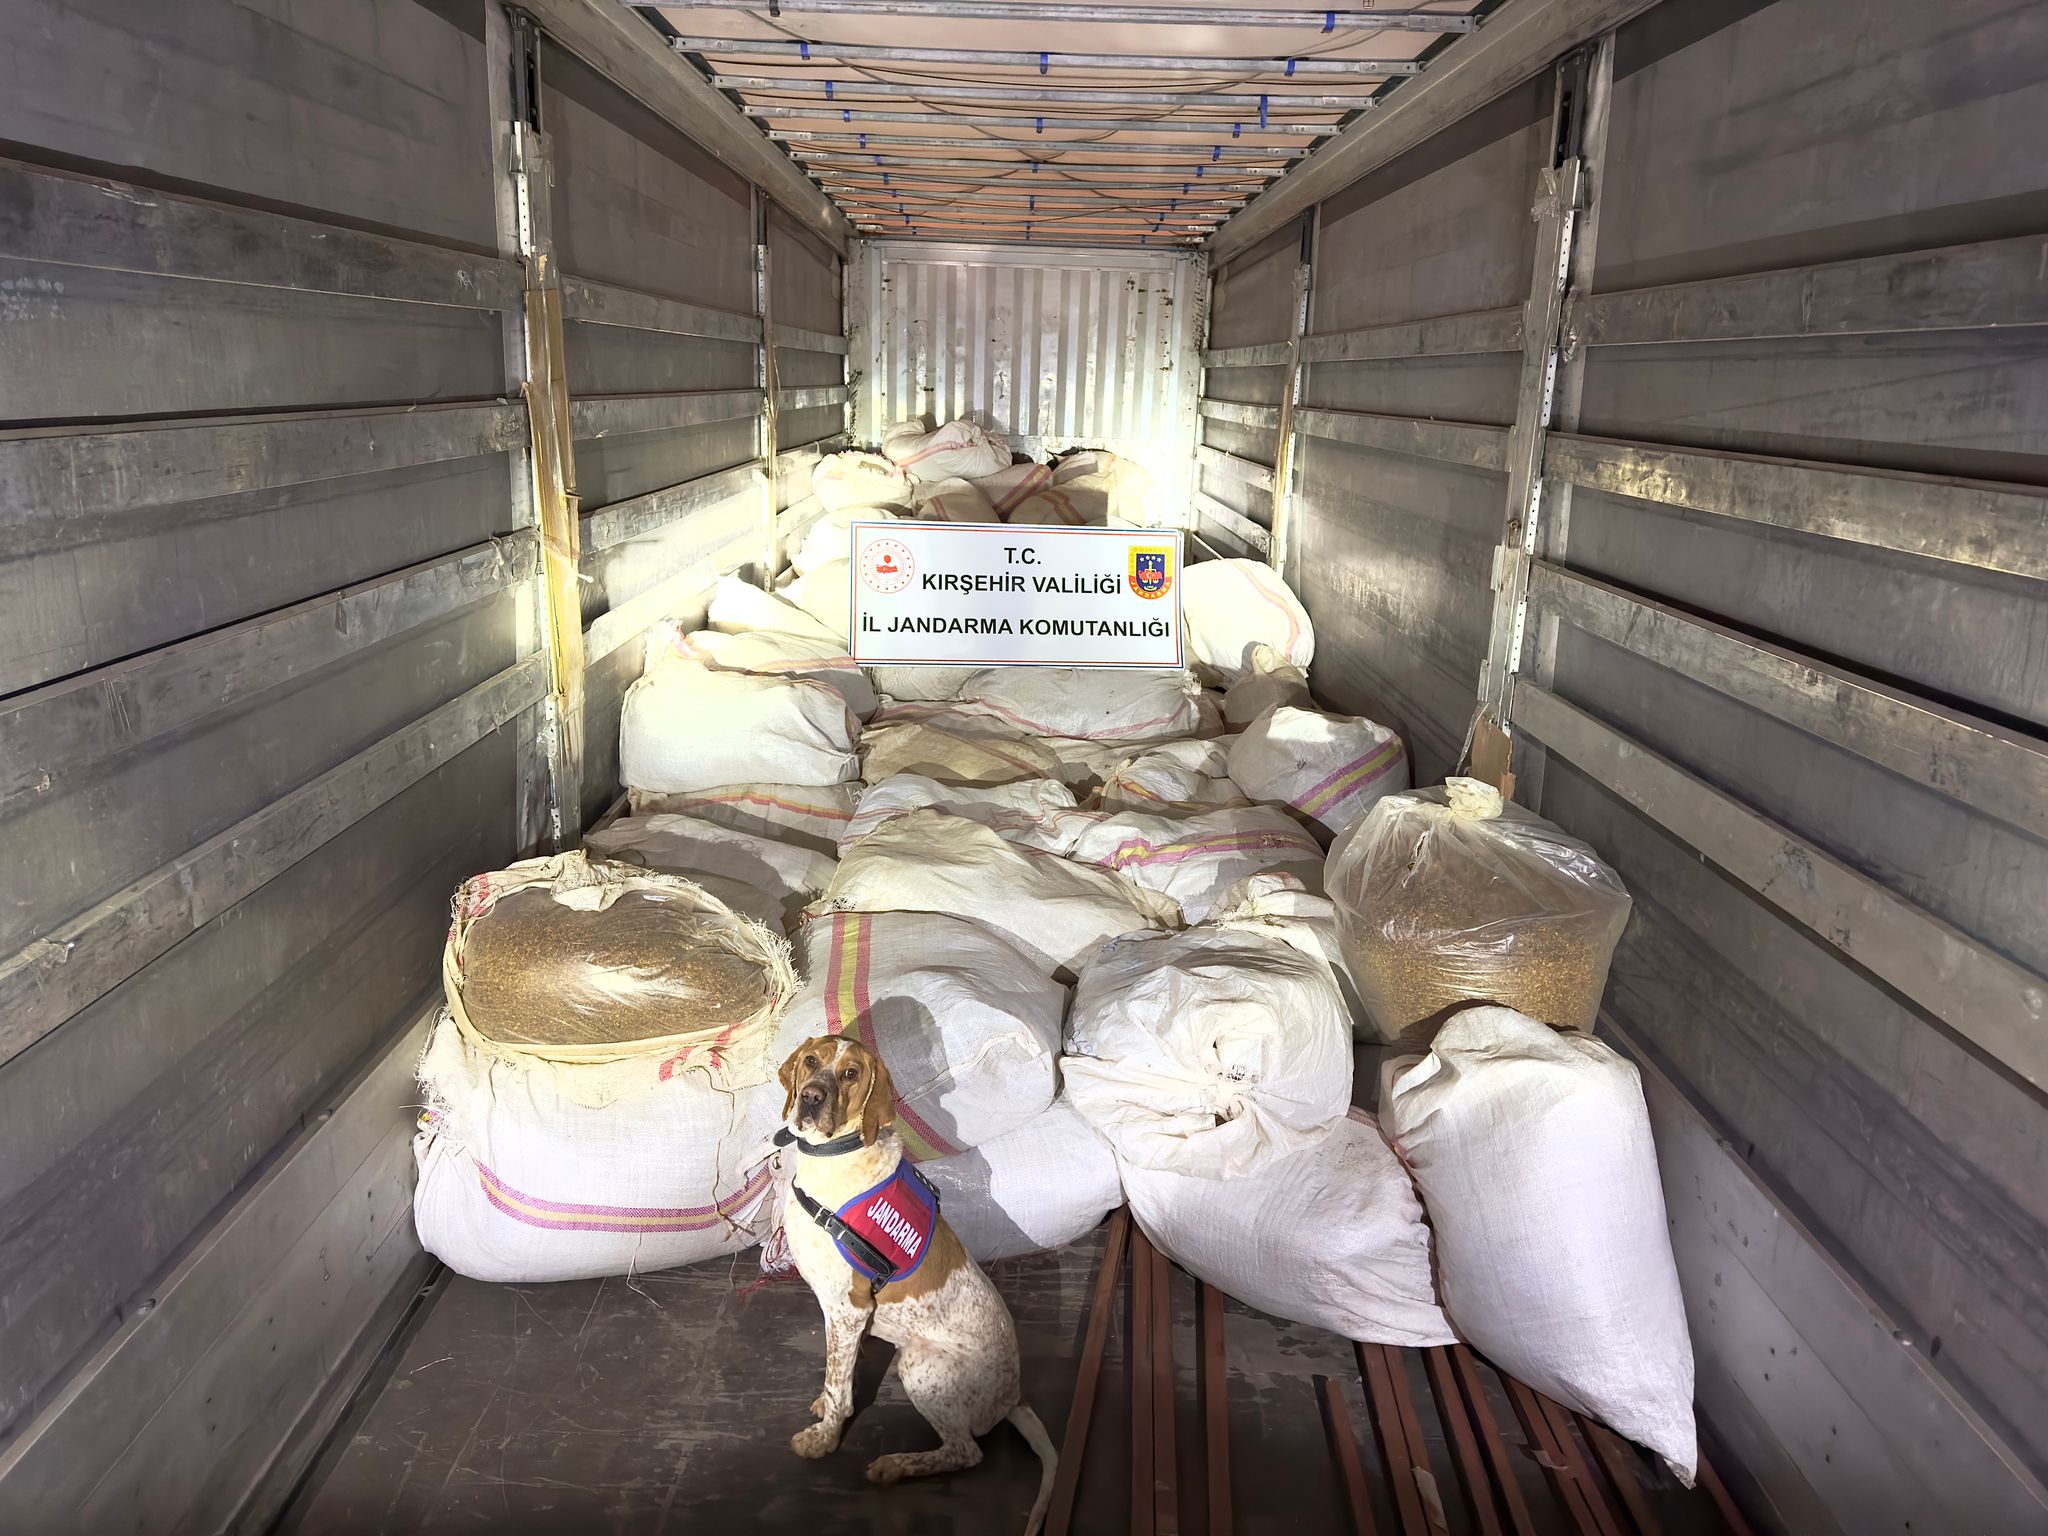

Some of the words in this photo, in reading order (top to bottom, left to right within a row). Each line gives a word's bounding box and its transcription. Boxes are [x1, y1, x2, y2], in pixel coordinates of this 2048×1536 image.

[1003, 547, 1041, 565] T.C.
[922, 571, 1025, 595] KIRŞEHİR
[1031, 572, 1121, 595] VALİLİĞİ
[1130, 580, 1171, 599] JANDARMA
[862, 611, 882, 632] İL
[888, 616, 1013, 635] JANDARMA
[1020, 616, 1170, 637] KOMUTANLIĞI
[867, 1197, 922, 1259] JANDARMA
